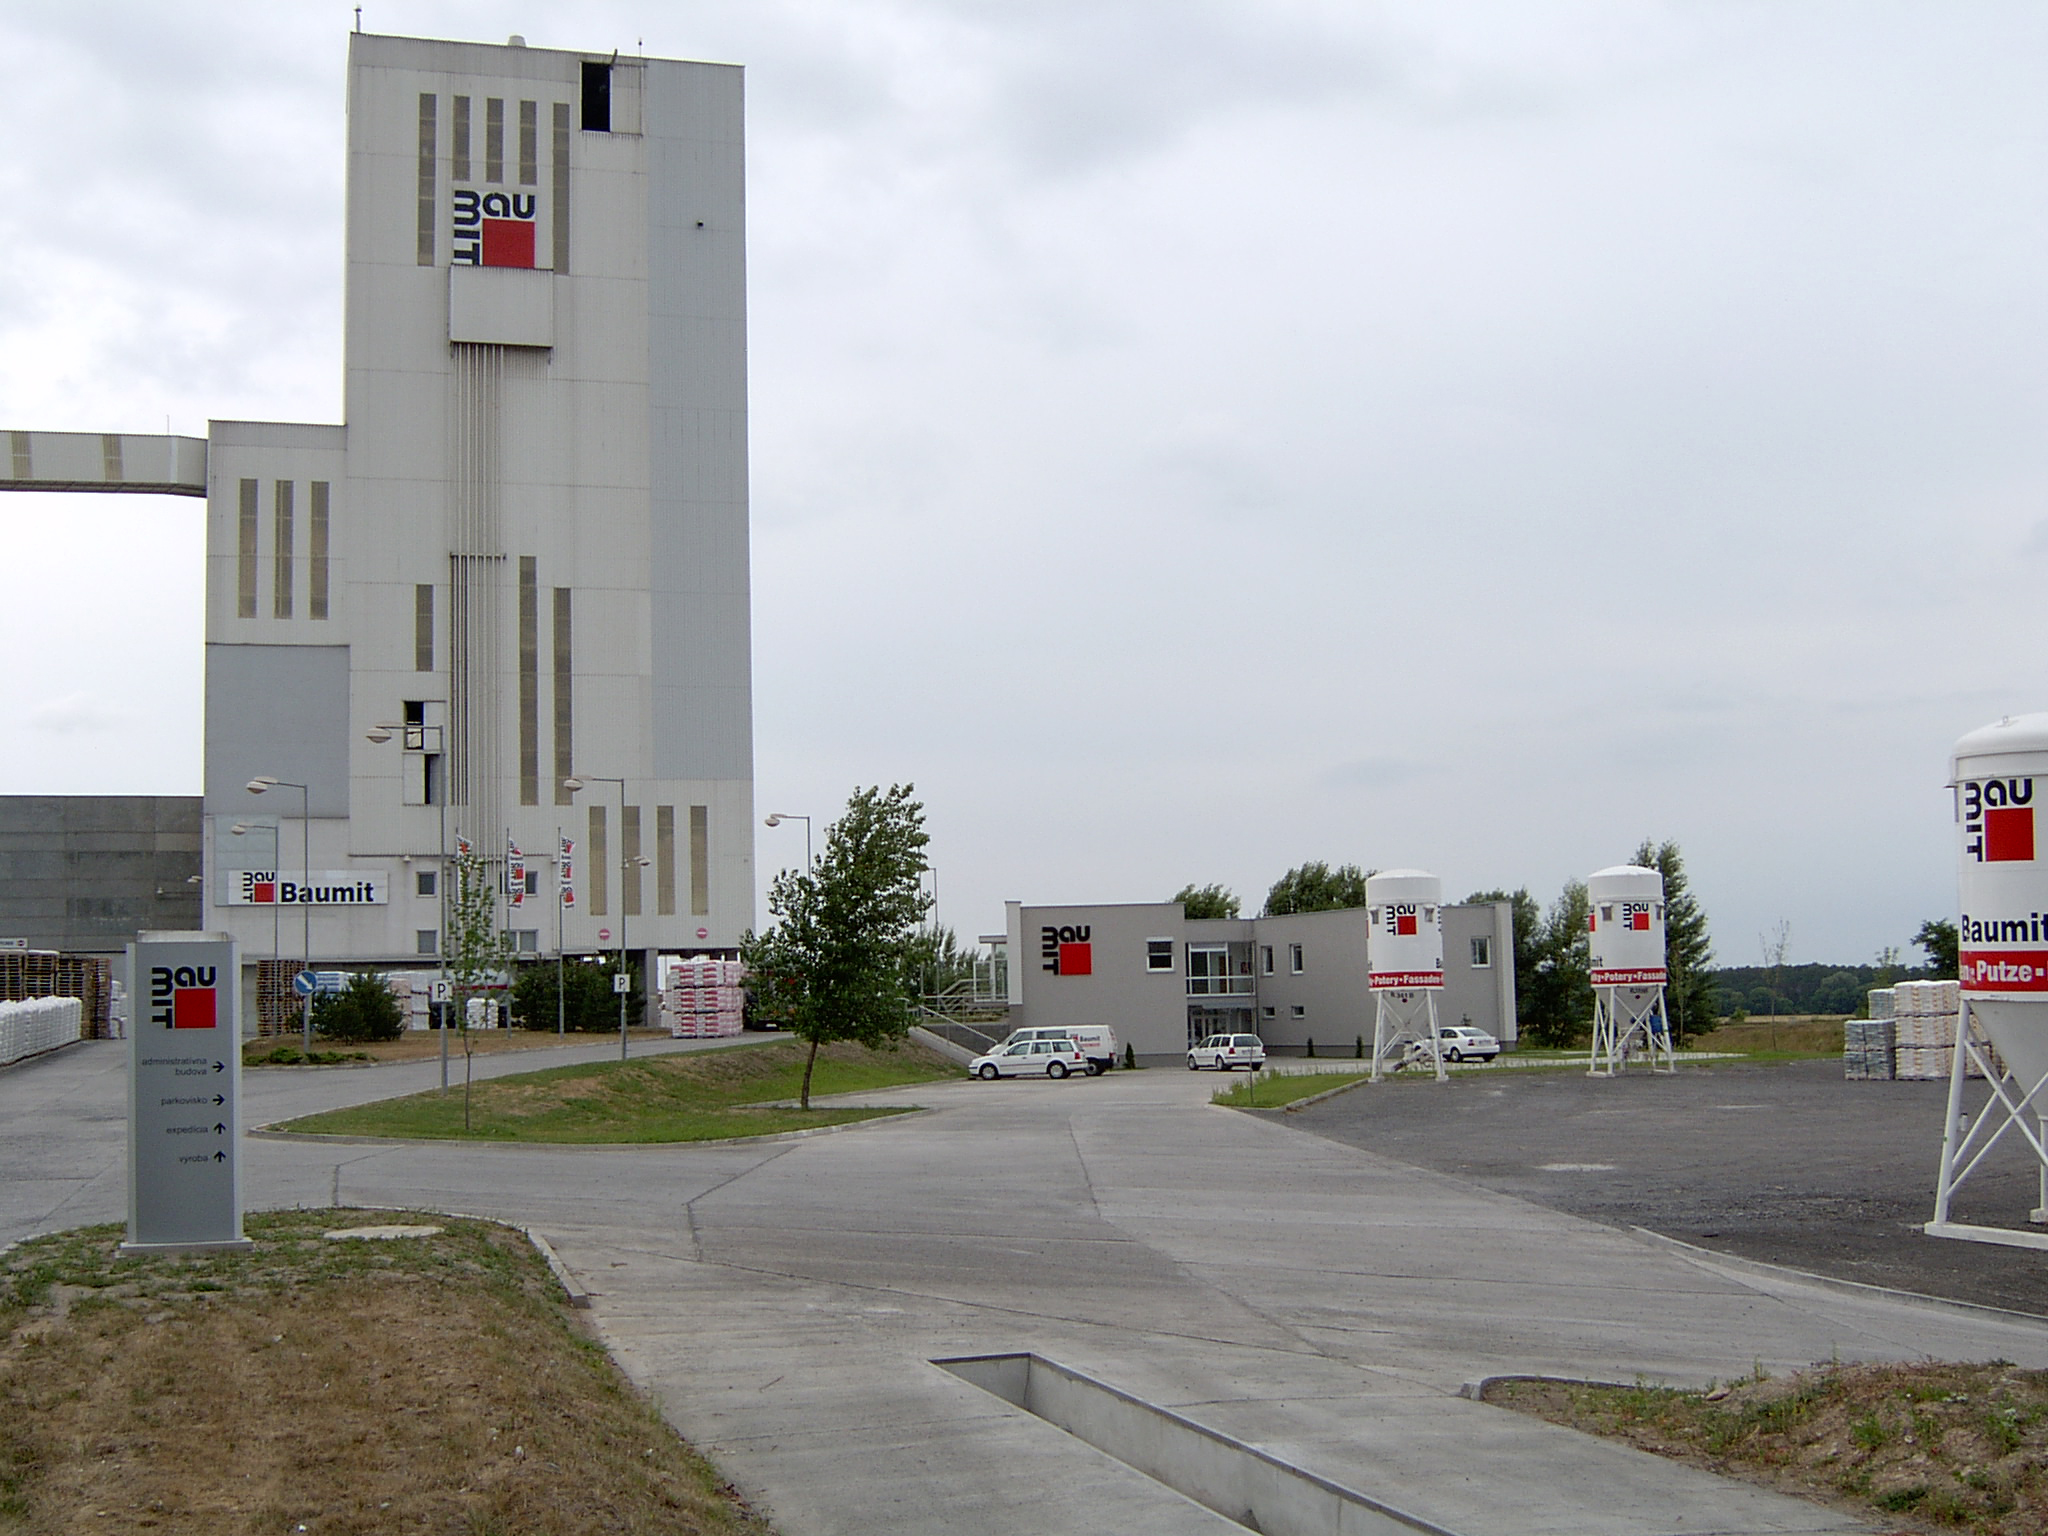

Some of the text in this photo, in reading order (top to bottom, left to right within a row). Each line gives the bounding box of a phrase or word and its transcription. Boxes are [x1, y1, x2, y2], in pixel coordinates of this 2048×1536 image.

[281, 882, 374, 902] Baumit
[1976, 960, 2033, 982] Putze
[619, 978, 626, 989] P
[437, 983, 446, 998] P
[175, 1067, 207, 1076] budova
[161, 1096, 208, 1106] parkovisko
